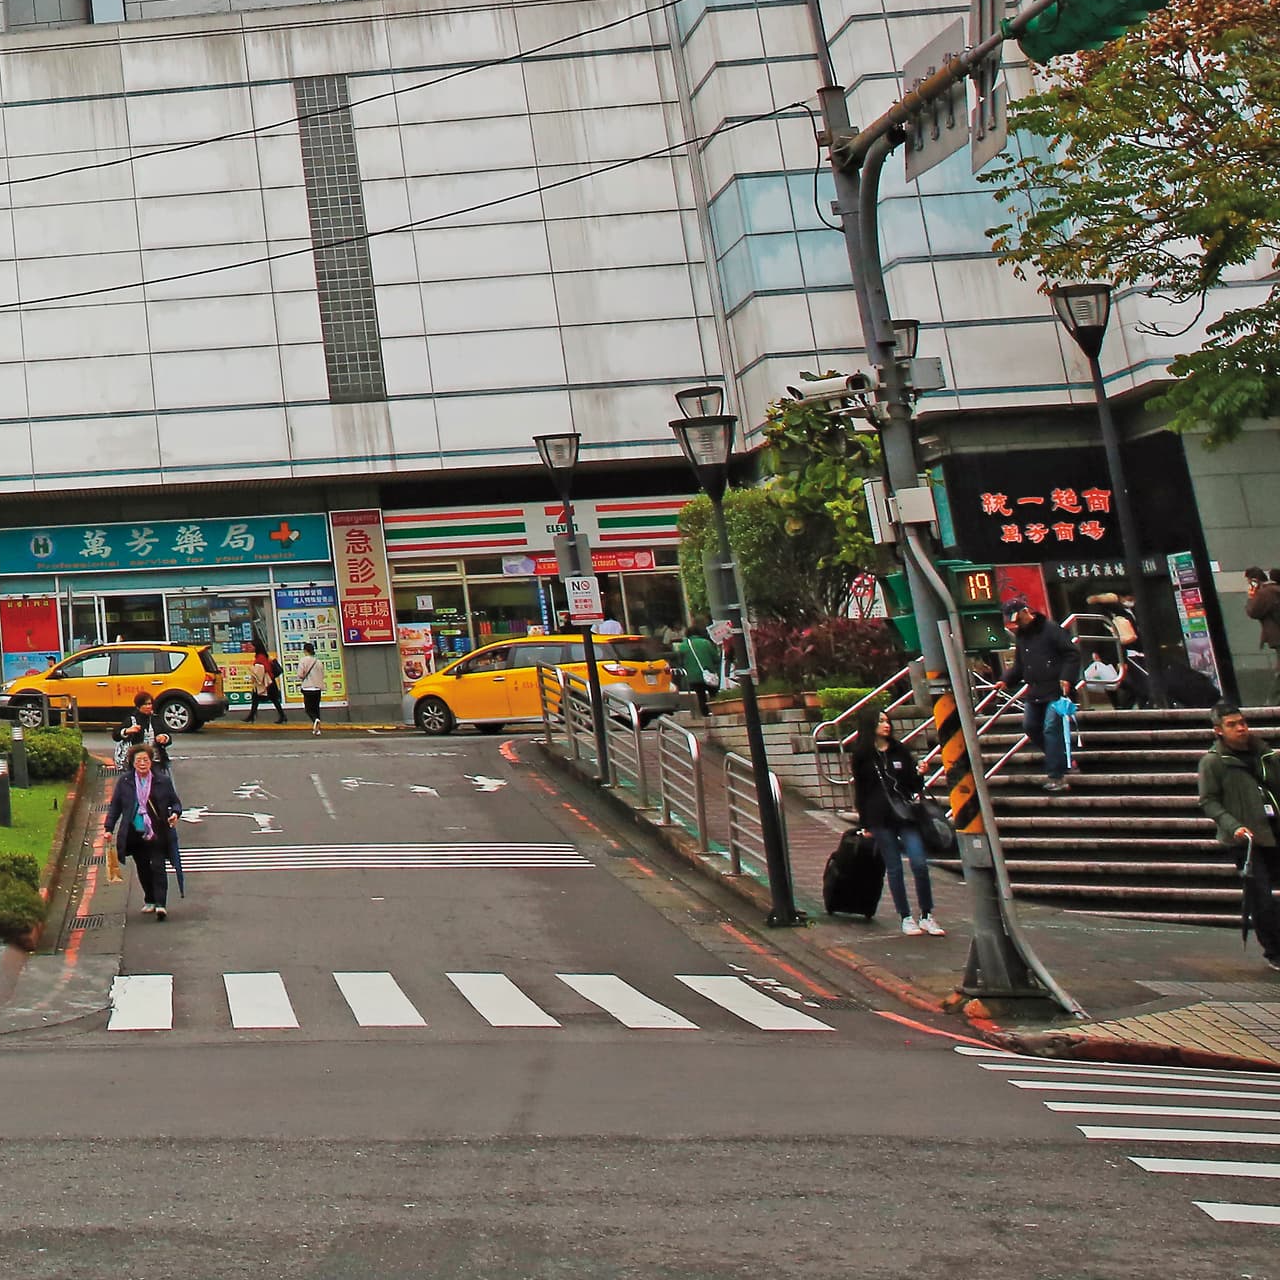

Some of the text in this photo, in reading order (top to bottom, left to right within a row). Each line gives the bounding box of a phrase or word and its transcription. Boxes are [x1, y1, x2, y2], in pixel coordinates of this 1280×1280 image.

[980, 487, 1112, 517] 統一超商
[79, 524, 255, 558] 萬芳藥局
[1000, 521, 1105, 543] 萬芳商場
[345, 529, 376, 583] 急診
[968, 573, 991, 600] 19
[344, 601, 389, 619] 停車場
[351, 618, 384, 627] Parking
